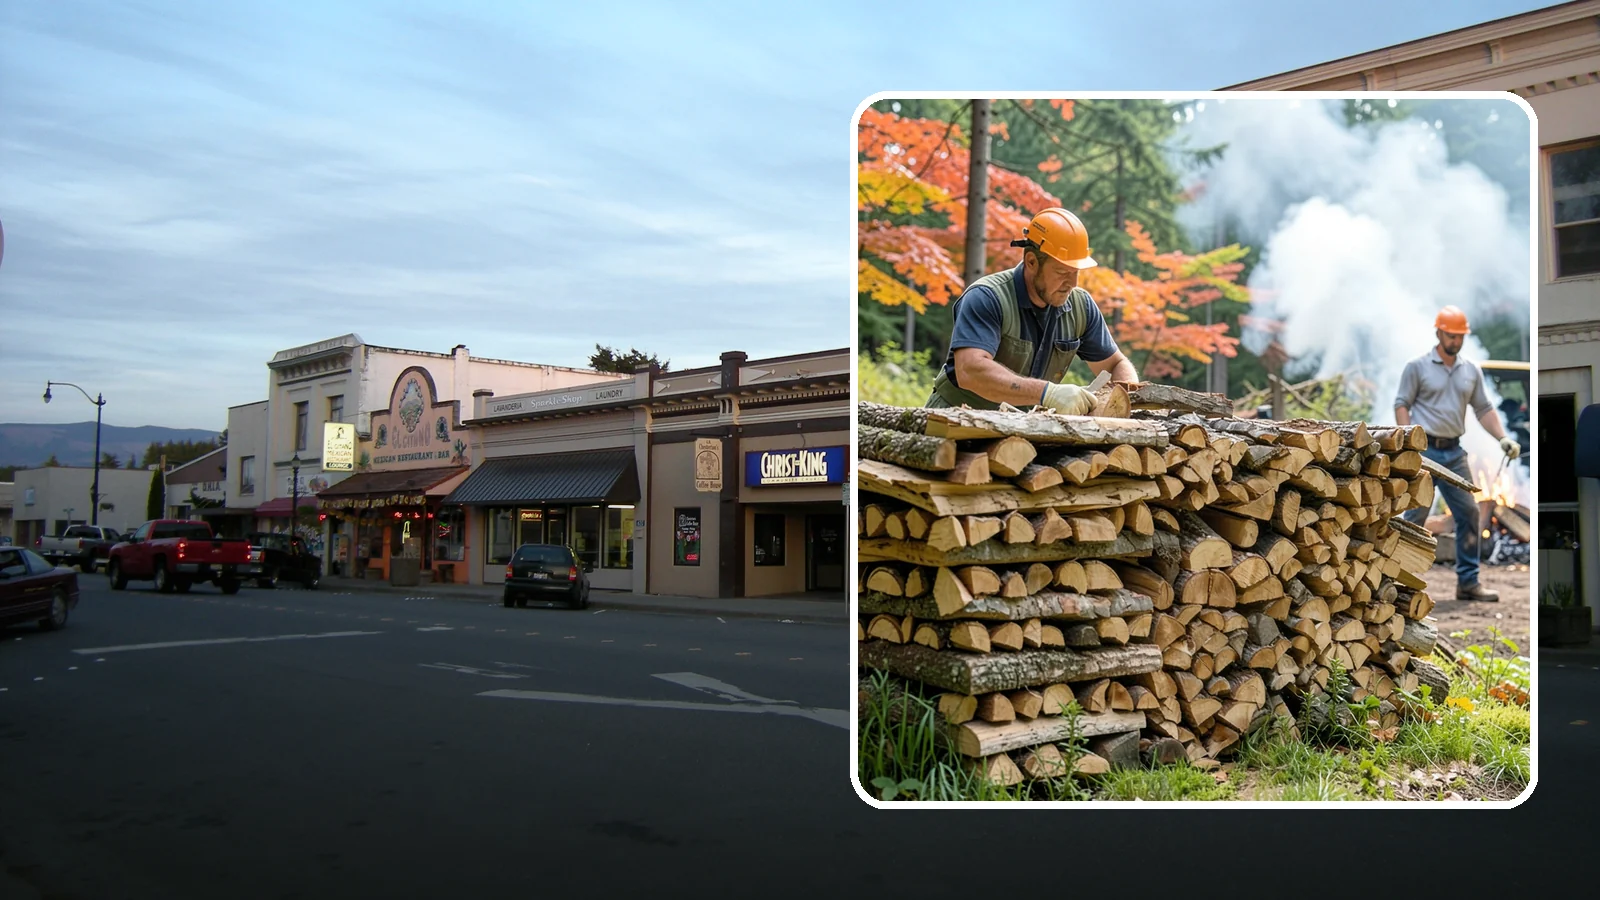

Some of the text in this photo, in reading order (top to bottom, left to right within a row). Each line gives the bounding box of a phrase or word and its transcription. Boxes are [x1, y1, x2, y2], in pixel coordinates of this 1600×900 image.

[493, 402, 522, 412] LAVANDERIA
[595, 389, 623, 400] LAUNDRY
[373, 455, 397, 464] MEXICAN
[397, 451, 433, 463] RESTAURANT
[437, 450, 450, 459] BAR
[761, 449, 827, 478] CHRIST KING
